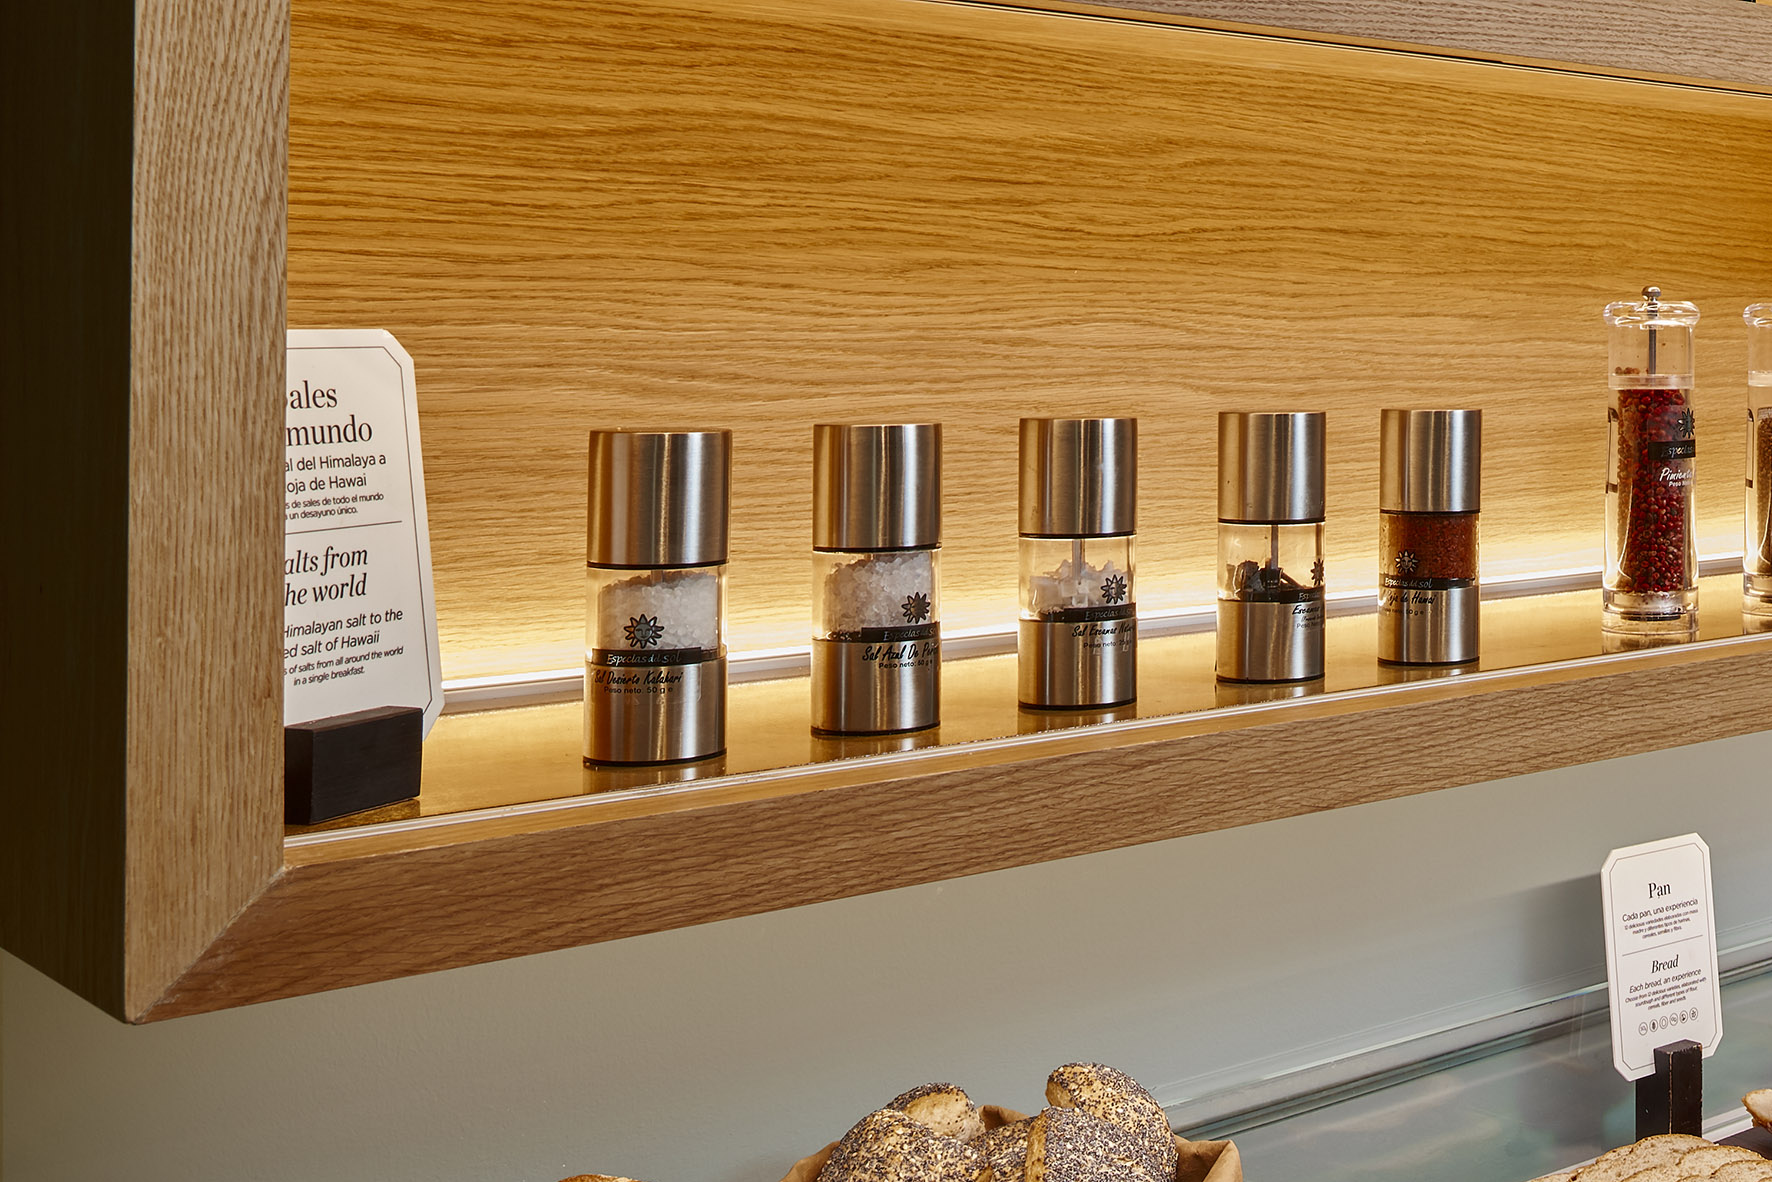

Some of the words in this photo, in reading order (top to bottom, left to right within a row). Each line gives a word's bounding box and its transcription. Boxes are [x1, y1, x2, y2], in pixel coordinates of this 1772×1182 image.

[287, 380, 338, 409] ales
[286, 414, 373, 446] mundo
[285, 457, 293, 472] al
[296, 456, 316, 471] del
[320, 453, 376, 469] Himalaya
[379, 454, 387, 465] a
[286, 478, 306, 495] oja
[309, 477, 326, 491] de
[329, 473, 367, 489] Hawai
[291, 500, 301, 509] de
[302, 498, 320, 507] sales
[322, 497, 331, 506] de
[333, 495, 350, 504] todo
[352, 494, 358, 503] el
[359, 492, 384, 502] mundo
[289, 512, 299, 520] un
[300, 508, 336, 519] desayuno
[285, 550, 319, 575] alts
[320, 545, 368, 576] from
[285, 583, 307, 606] he
[312, 573, 367, 603] world
[346, 613, 366, 628] salt
[370, 612, 382, 625] to
[385, 609, 403, 622] the
[285, 643, 298, 659] ed
[301, 640, 322, 656] salt
[325, 637, 339, 652] of
[341, 631, 380, 649] Hawaii
[863, 645, 882, 660] Sal
[289, 663, 299, 675] of
[299, 661, 315, 672] salts
[316, 658, 334, 669] from
[335, 656, 344, 666] all
[345, 653, 370, 664] around
[371, 650, 383, 660] the
[384, 646, 404, 657] world
[294, 677, 301, 686] in
[308, 672, 330, 684] single
[608, 671, 640, 685] Desierto
[643, 669, 683, 685] Kalahari
[1648, 882, 1671, 898] Pan
[1622, 912, 1638, 922] Cada
[1653, 906, 1665, 915] una
[1665, 898, 1698, 912] experiencia
[1651, 954, 1679, 973] Bread
[1629, 983, 1643, 993] Each
[1645, 978, 1662, 989] bread,
[1663, 977, 1670, 985] an
[1672, 968, 1701, 982] experience
